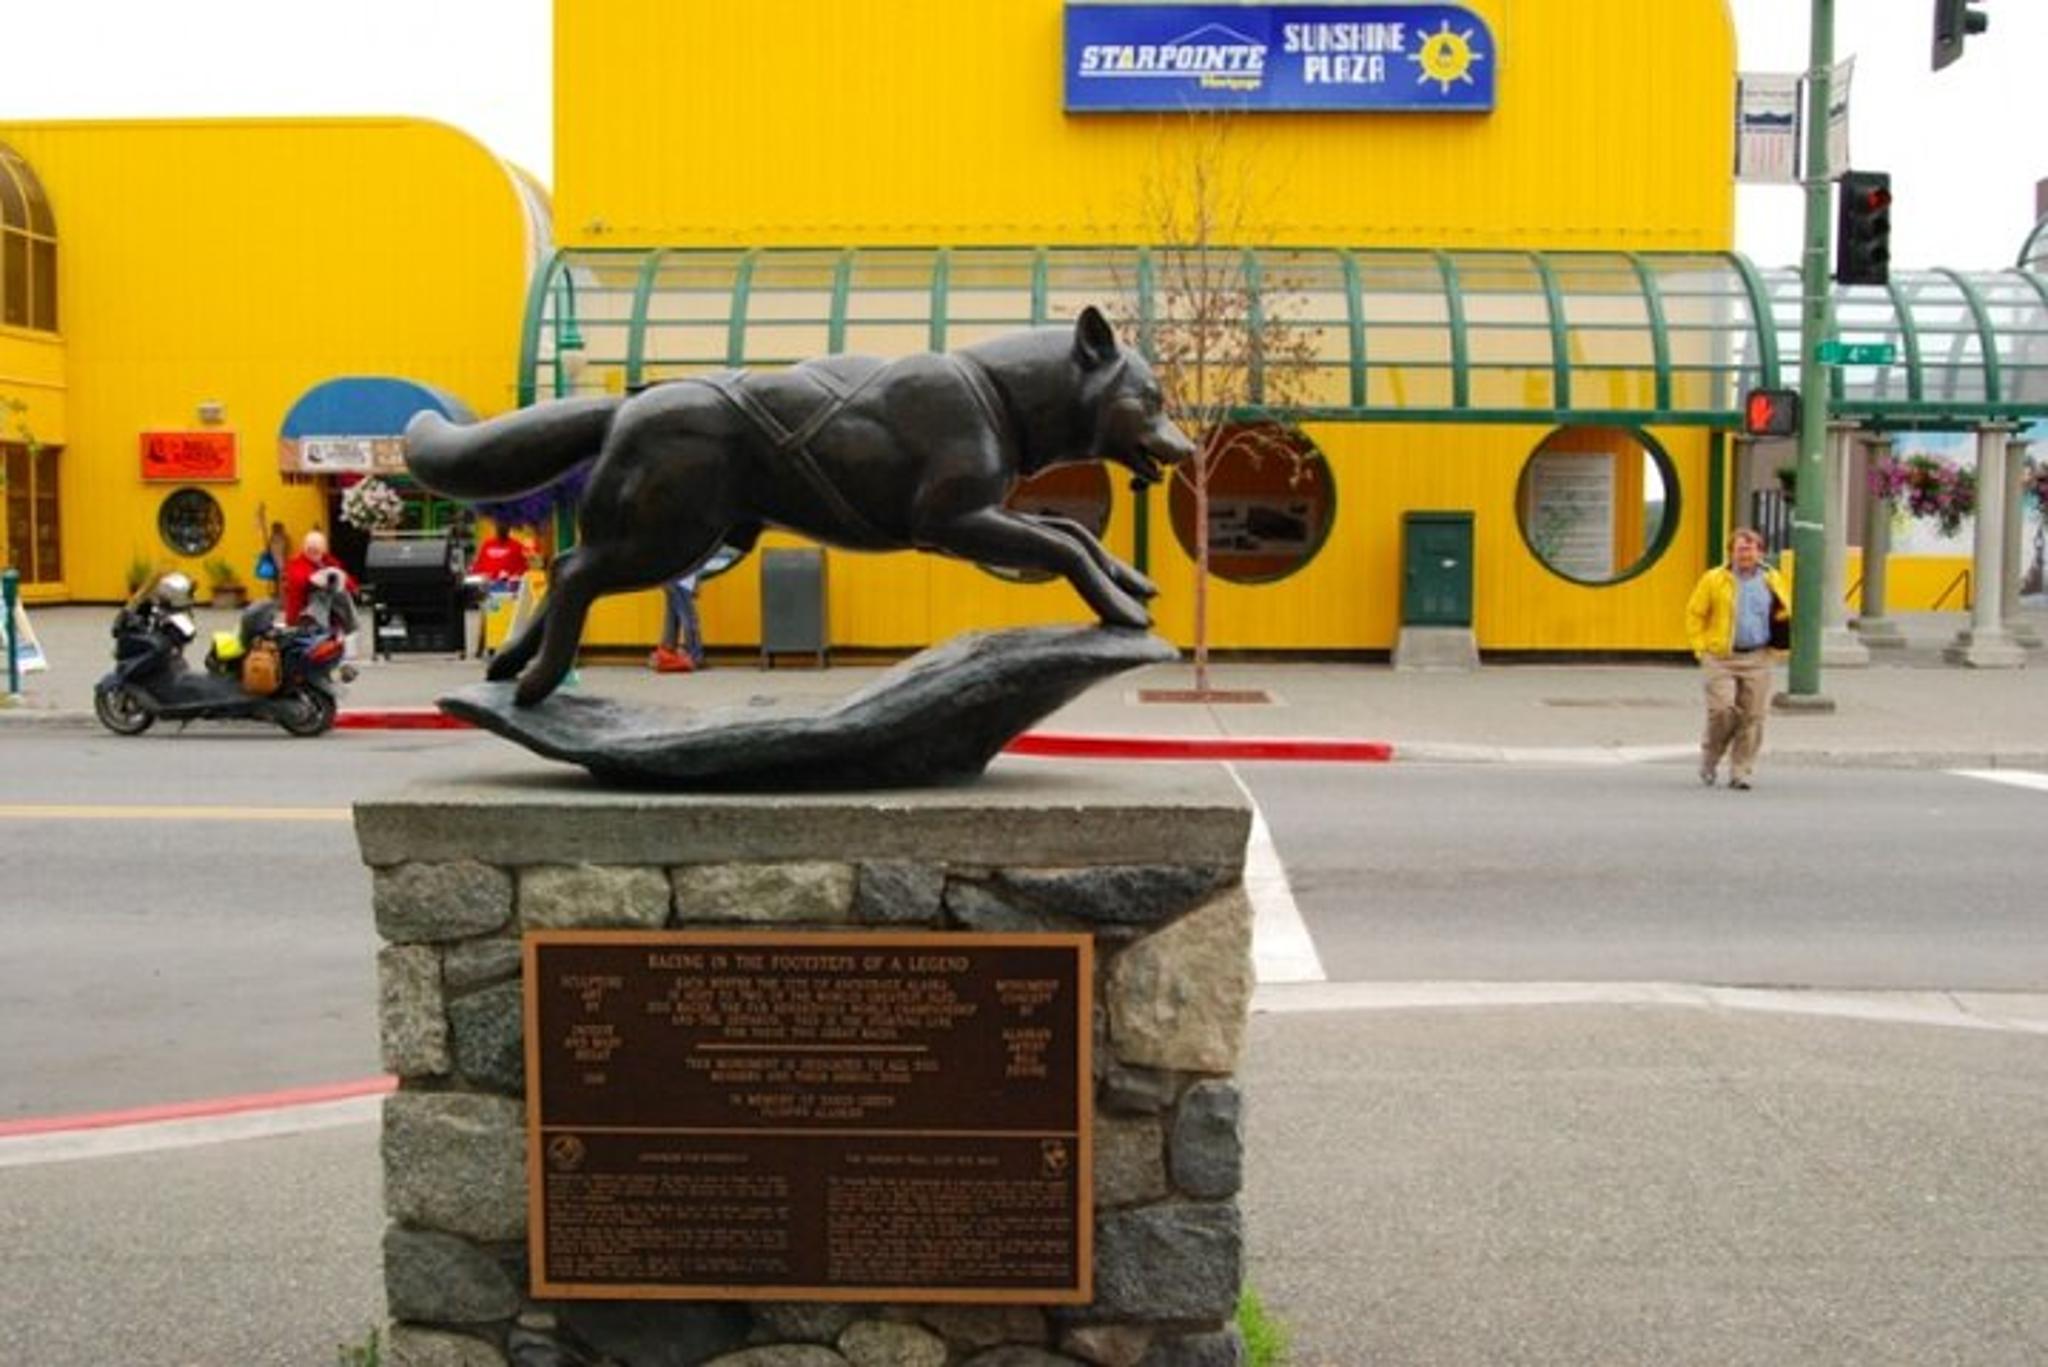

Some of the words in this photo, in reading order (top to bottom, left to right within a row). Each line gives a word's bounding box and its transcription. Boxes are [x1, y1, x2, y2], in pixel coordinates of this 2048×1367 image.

[1283, 23, 1405, 53] SUNSHINE
[1079, 45, 1269, 71] STARPOINTE
[1304, 55, 1385, 84] PLAZA
[649, 954, 705, 969] RACING
[711, 954, 728, 969] IN
[737, 955, 763, 970] THE
[771, 955, 856, 970] FOOTSTEPS
[863, 955, 885, 970] OF
[891, 956, 902, 971] A
[909, 956, 970, 971] LEGEND
